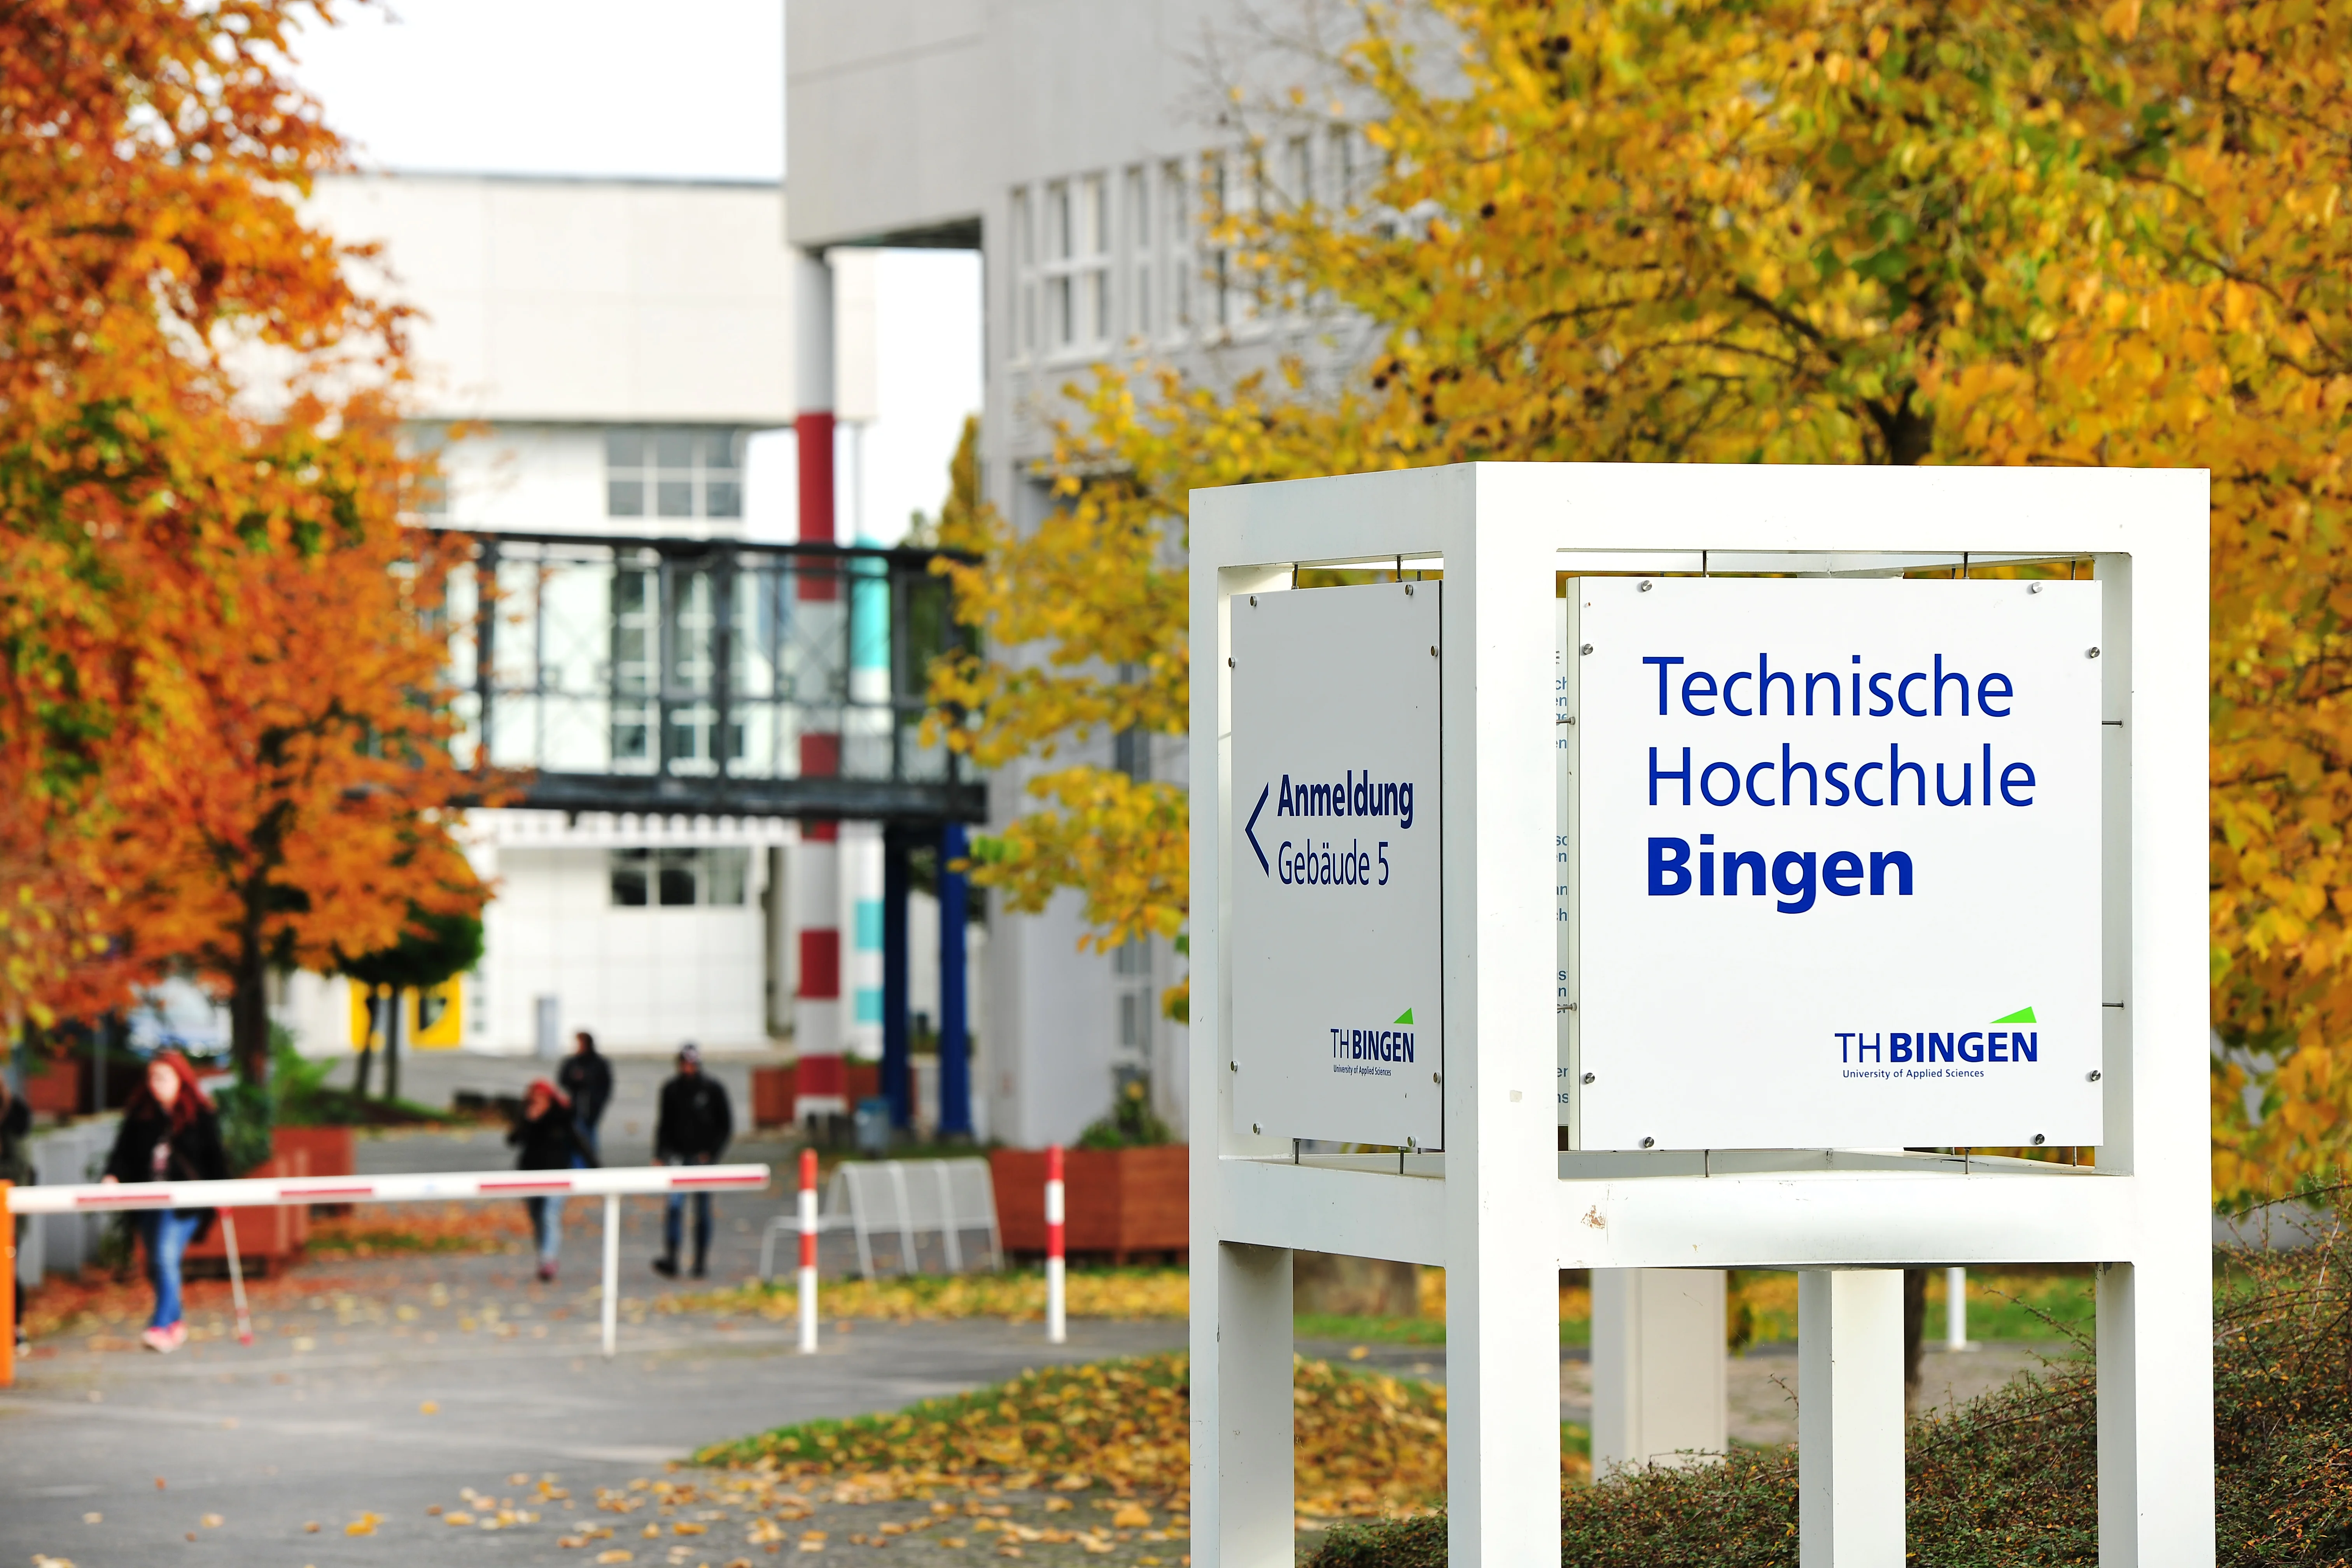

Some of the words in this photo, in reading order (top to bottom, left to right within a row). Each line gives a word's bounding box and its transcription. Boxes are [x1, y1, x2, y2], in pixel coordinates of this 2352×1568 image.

[1642, 652, 2014, 718] Technische
[1648, 742, 2036, 807] Hochschule
[1277, 769, 1414, 830] Anmeldung
[1278, 838, 1370, 886] Gebäude
[1378, 841, 1389, 886] 5
[1647, 833, 1913, 915] Bingen
[1330, 1028, 1349, 1059] TH
[1352, 1029, 1414, 1063] BINGEN
[1834, 1032, 1881, 1063] TH
[1890, 1032, 2038, 1063] BINGEN
[1333, 1064, 1353, 1076] University
[1353, 1065, 1358, 1074] of
[1358, 1066, 1374, 1077] Applied
[1375, 1067, 1391, 1076] Sciences
[1843, 1069, 1891, 1080] University
[1893, 1068, 1904, 1078] of
[1906, 1068, 1942, 1080] Applied
[1945, 1068, 1984, 1078] Sciences
